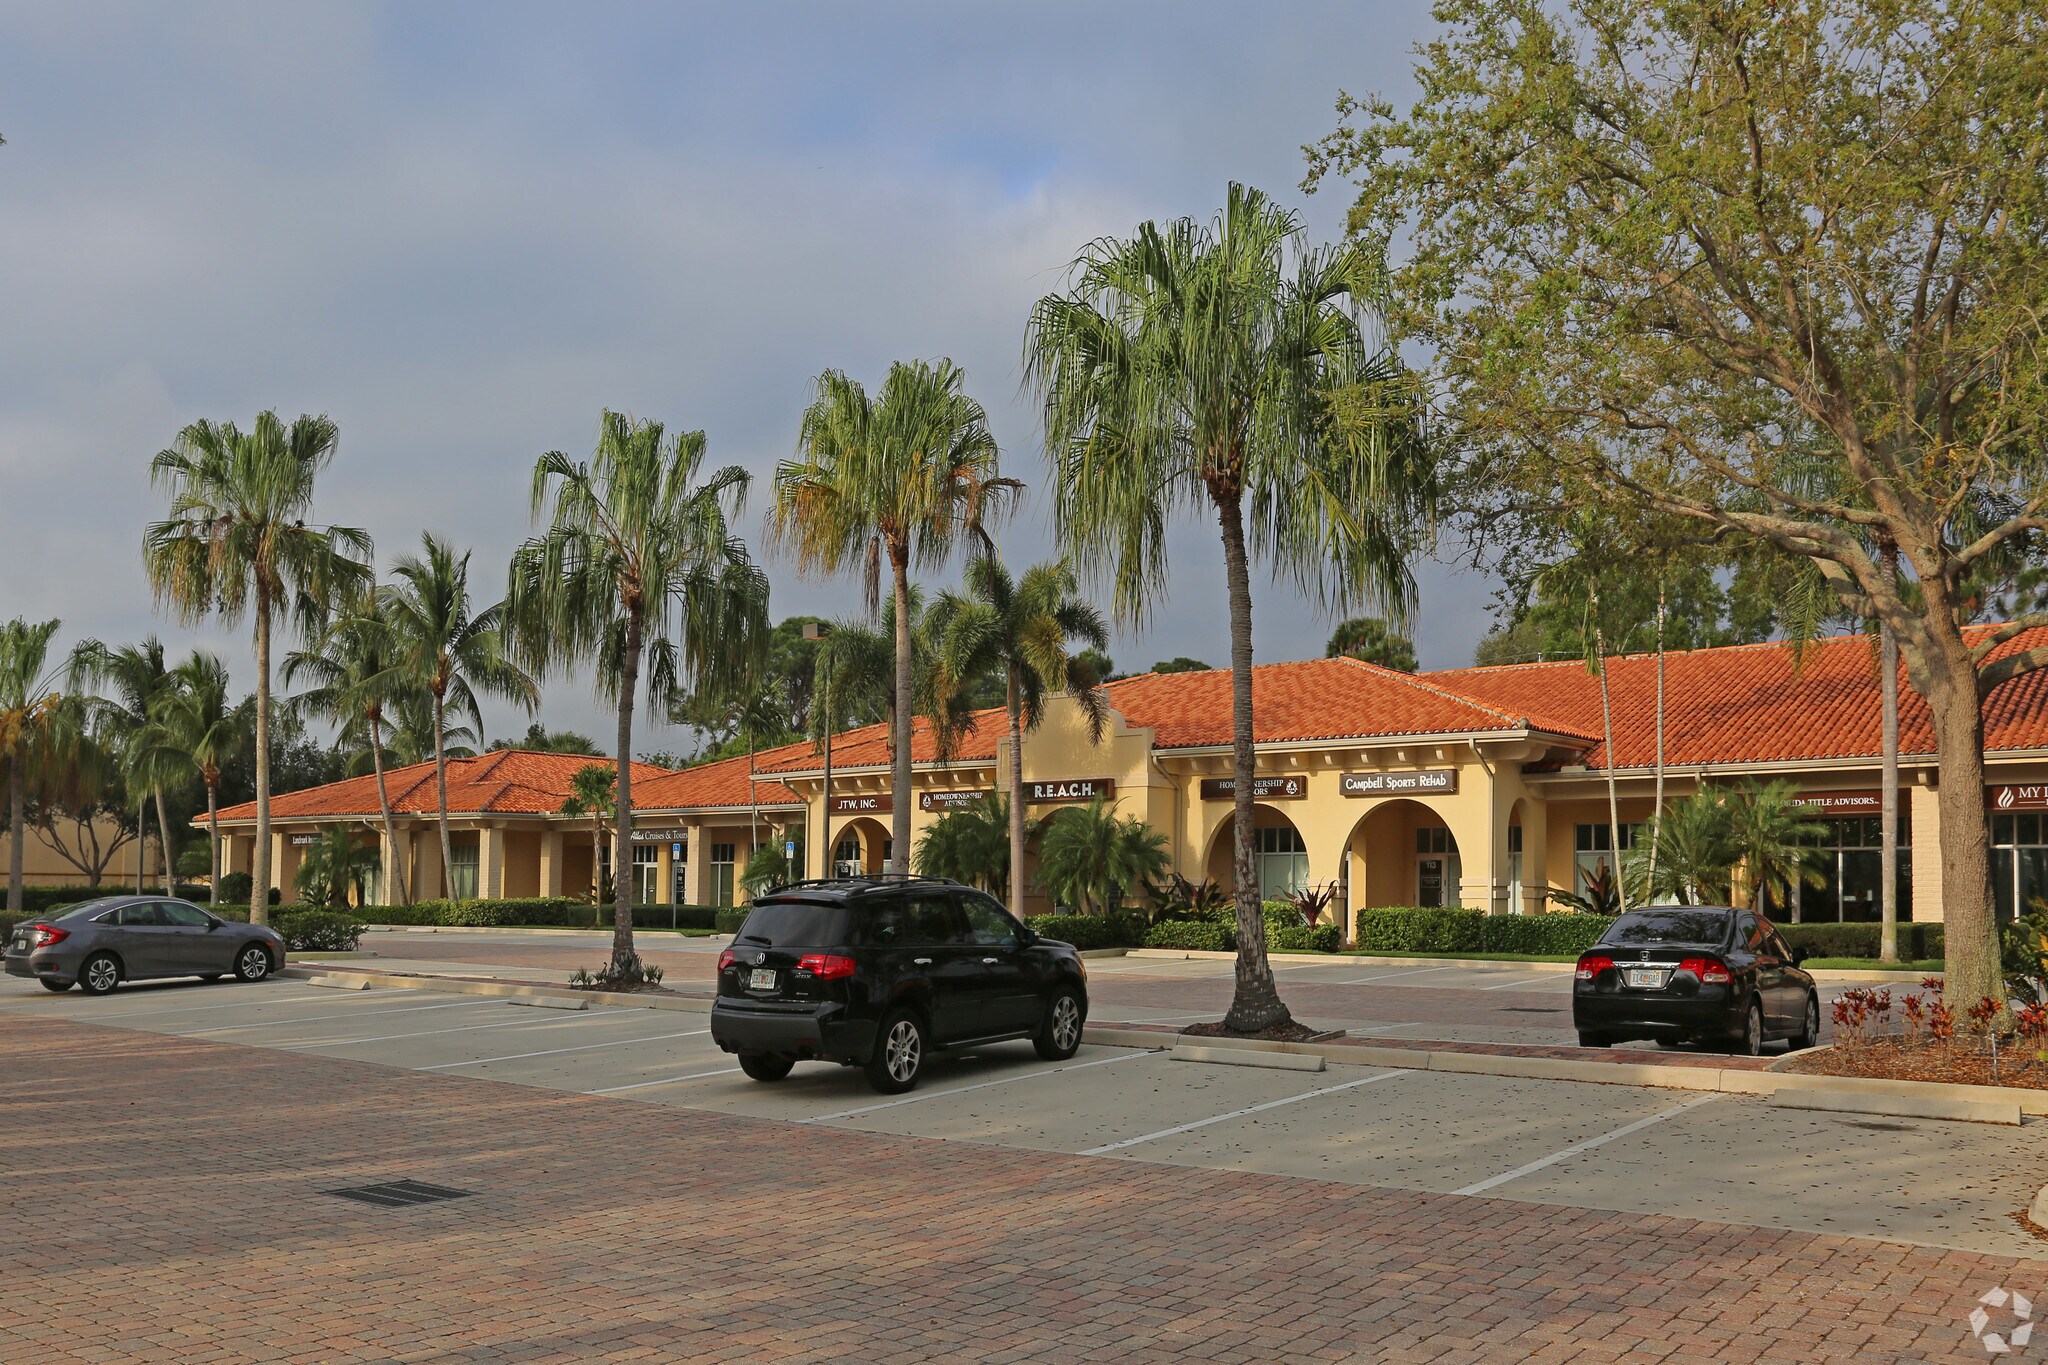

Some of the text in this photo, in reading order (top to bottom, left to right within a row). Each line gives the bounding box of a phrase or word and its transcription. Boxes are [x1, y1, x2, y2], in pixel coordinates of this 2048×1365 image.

[1345, 774, 1446, 791] Campbell Sports Rehab
[1034, 782, 1095, 798] R.E.A.C.H.
[2018, 786, 2041, 798] MY
[838, 799, 878, 810] JTW, INC.
[1807, 798, 1833, 806] TITLE
[1833, 797, 1875, 806] ADVISORS
[644, 830, 665, 840] Cruises
[672, 830, 688, 840] Tours
